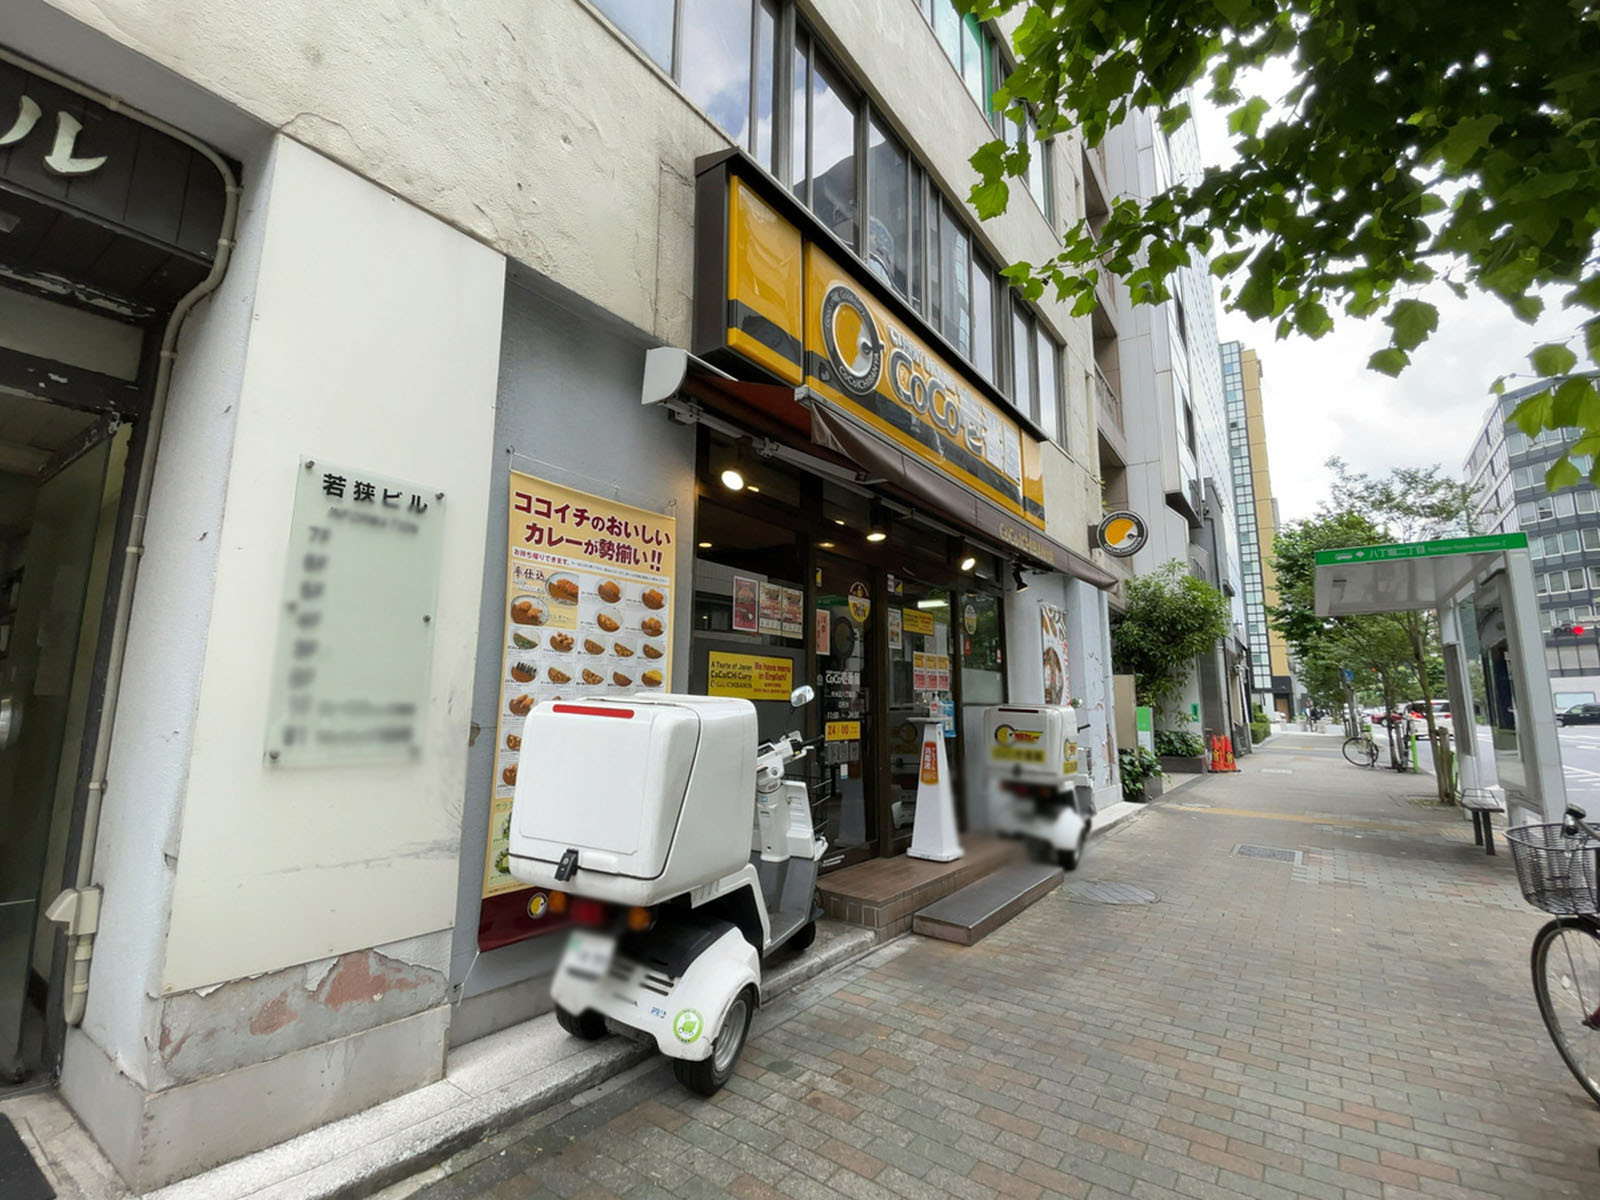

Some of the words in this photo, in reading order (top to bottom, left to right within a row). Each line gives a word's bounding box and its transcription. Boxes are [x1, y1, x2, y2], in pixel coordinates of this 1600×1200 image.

[322, 472, 428, 513] 若狭ビル
[513, 490, 671, 547] ココイチのおいしい
